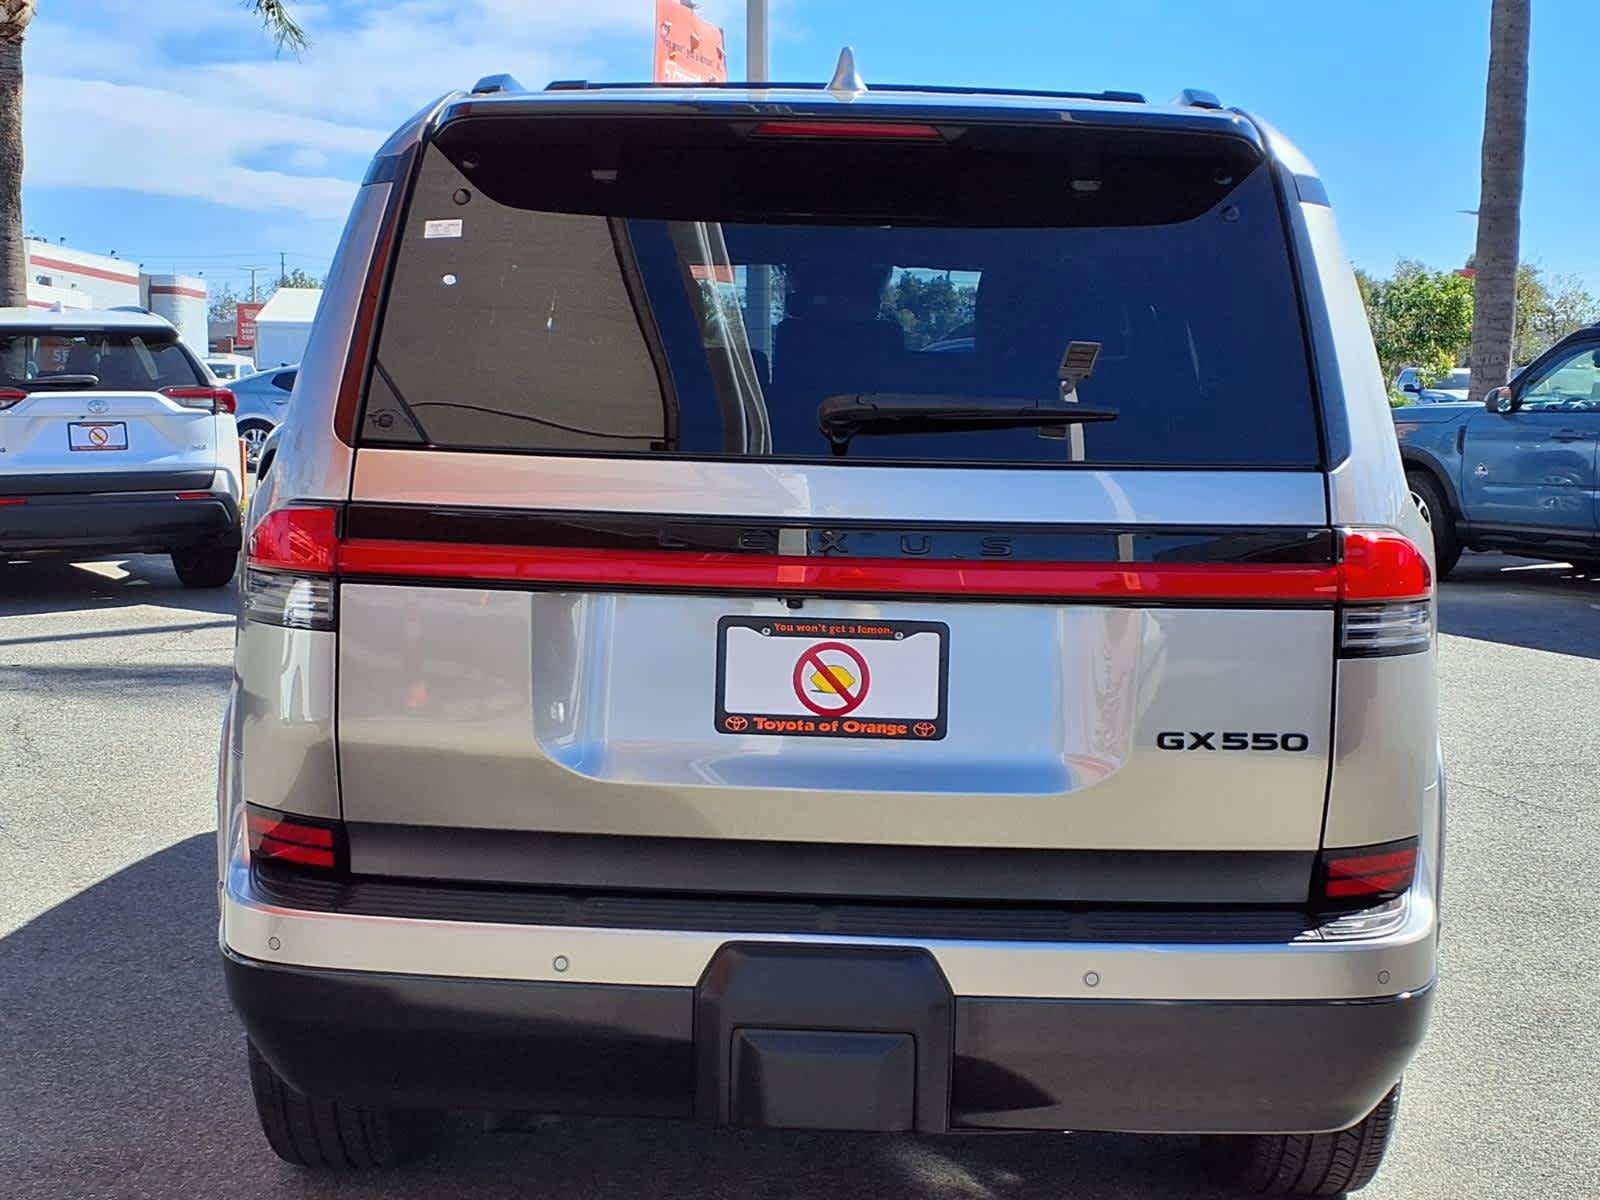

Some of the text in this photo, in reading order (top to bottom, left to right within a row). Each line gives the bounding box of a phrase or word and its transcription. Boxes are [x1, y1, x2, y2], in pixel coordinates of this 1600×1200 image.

[657, 528, 1013, 557] LEXUS
[774, 623, 794, 632] You
[796, 623, 826, 633] won't
[829, 624, 846, 635] get
[857, 625, 894, 635] lemon.
[753, 717, 907, 736] Toyota of Orange
